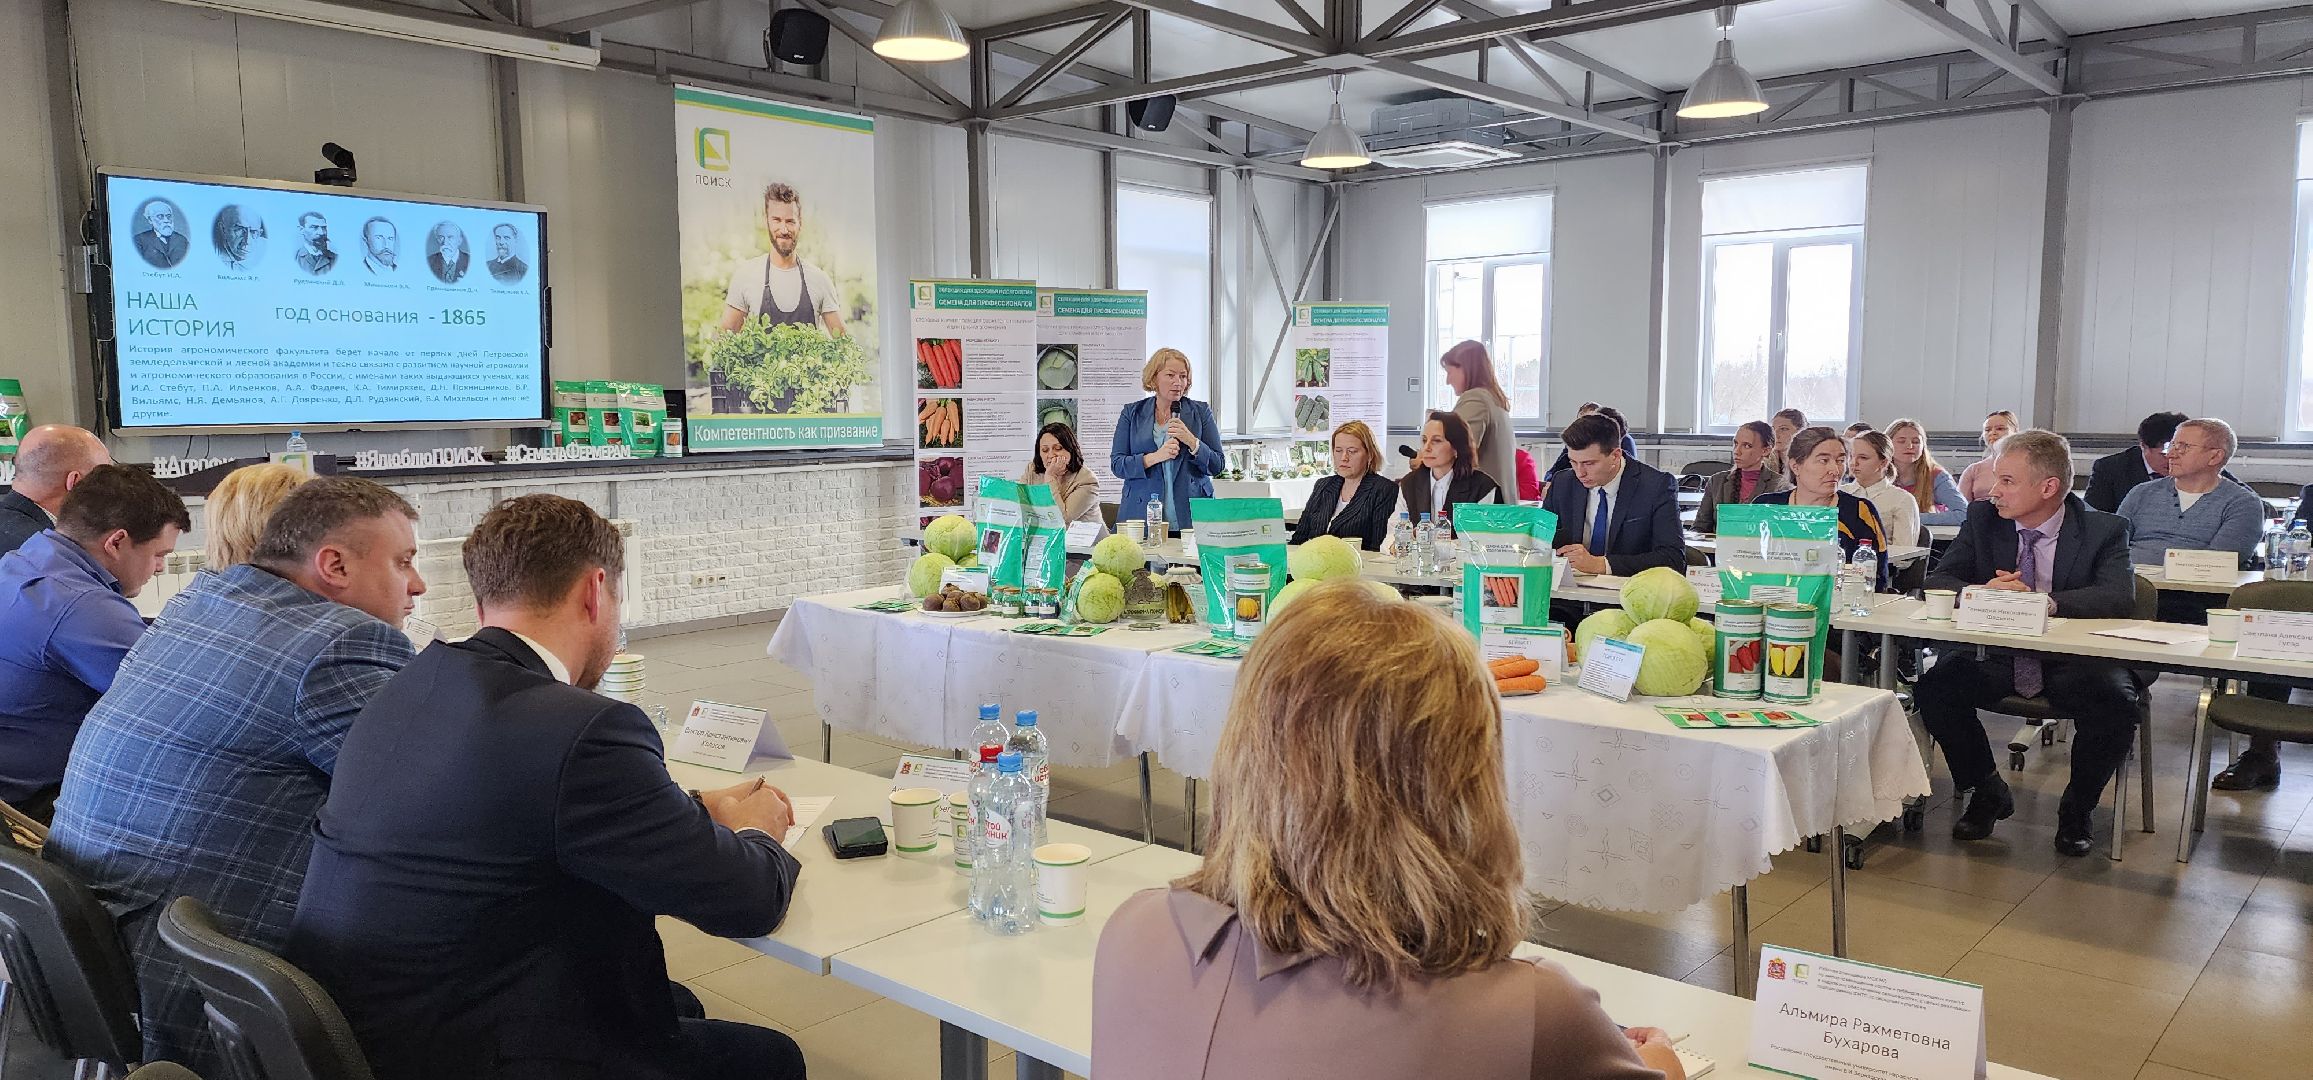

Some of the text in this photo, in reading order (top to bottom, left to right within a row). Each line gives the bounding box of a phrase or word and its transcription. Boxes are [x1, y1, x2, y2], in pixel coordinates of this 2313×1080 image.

[695, 174, 732, 189] ПОИСК
[126, 291, 199, 311] НАША
[275, 307, 311, 324] год
[316, 308, 418, 324] основания
[441, 308, 486, 326] 1865
[128, 318, 235, 338] ИСТОРИЯ
[129, 344, 173, 354] История
[181, 346, 269, 356] агрономического
[275, 346, 329, 356] факультета
[335, 348, 362, 357] берет
[457, 350, 478, 358] дней
[483, 350, 529, 359] Петровской
[129, 358, 223, 367] земледельческой
[235, 358, 270, 367] лесной
[273, 360, 320, 368] академии
[141, 372, 232, 381] агрономического
[235, 371, 299, 380] образования
[310, 371, 344, 381] России,
[159, 383, 196, 393] Стебут,
[229, 384, 280, 393] Ильенков,
[132, 396, 181, 406] Вильямс,
[211, 396, 265, 405] Демьянов,
[368, 395, 422, 404] Рудзинский,
[132, 410, 173, 420] другие.
[694, 424, 878, 444] Компетентность как призвание
[1779, 1002, 1848, 1028] Альмира
[1853, 1017, 1951, 1051] Рахметовна
[1823, 1031, 1899, 1060] Бухарова
